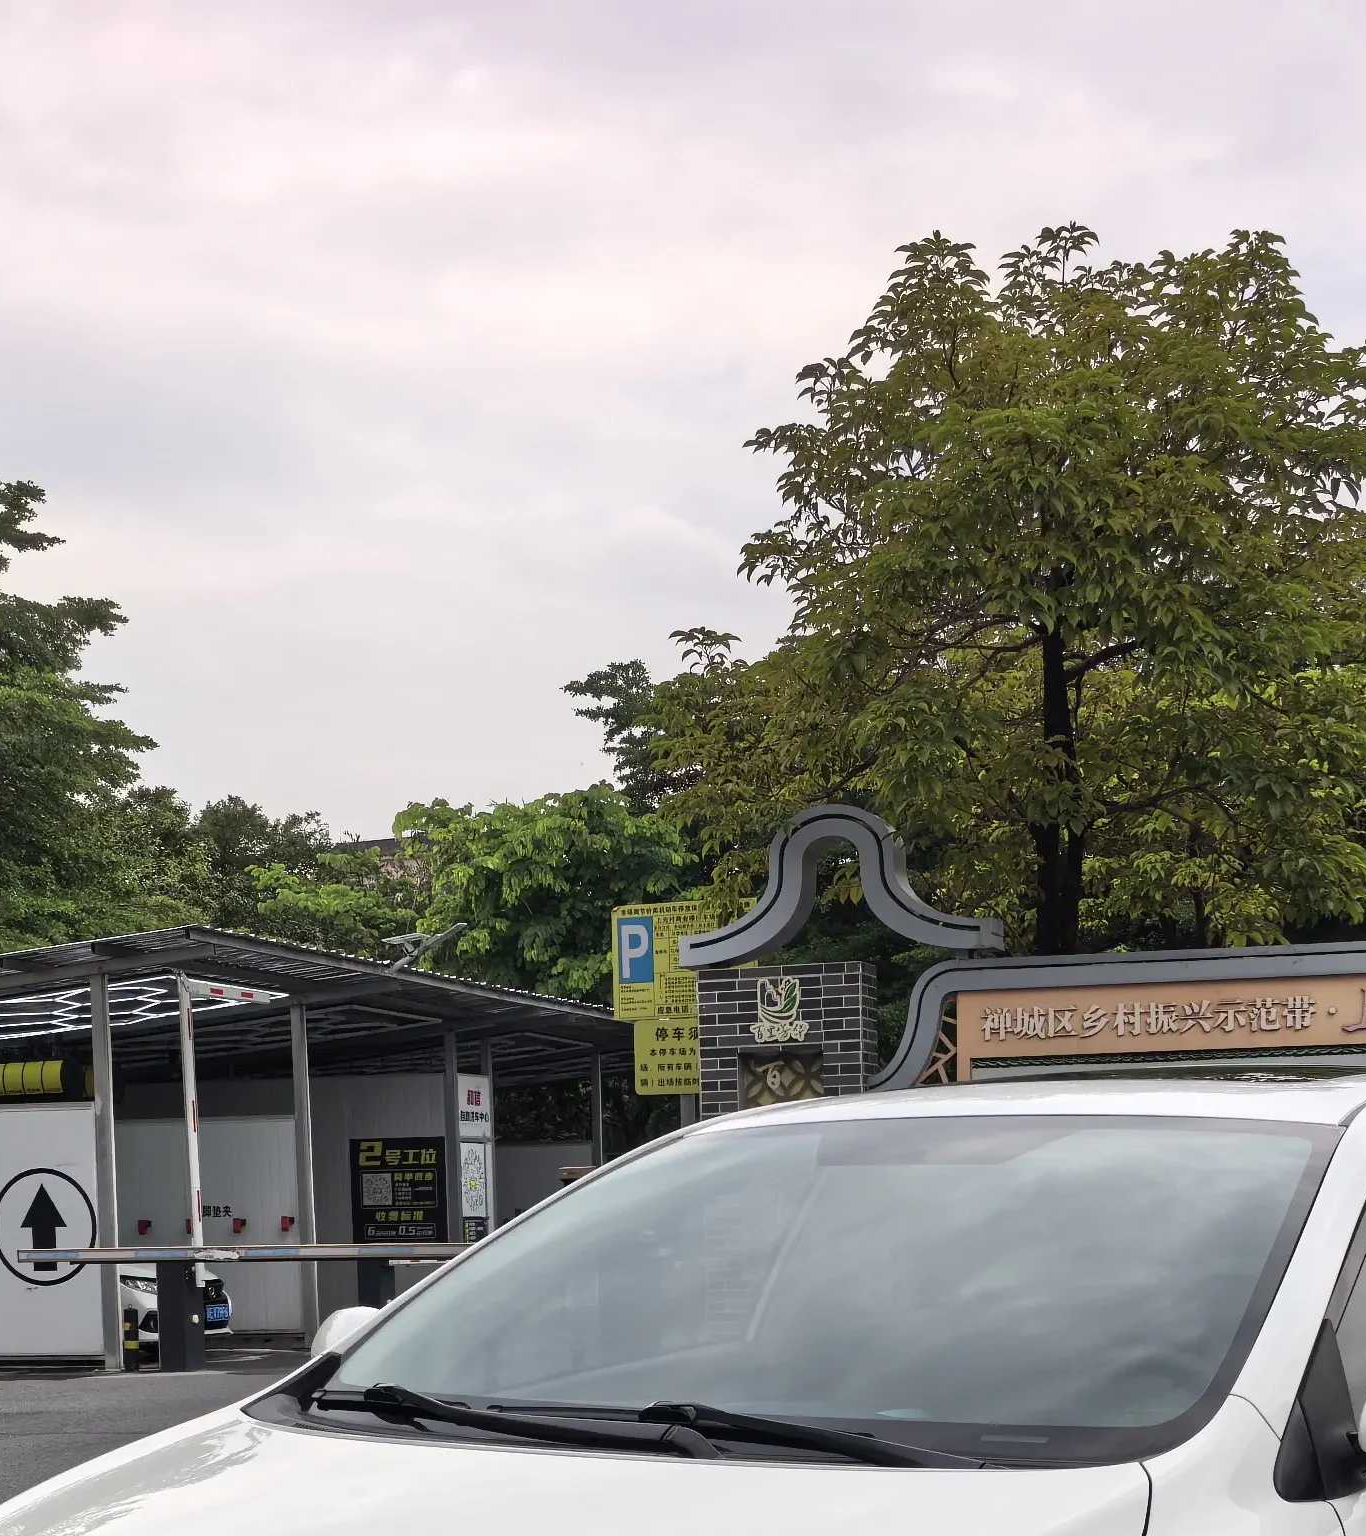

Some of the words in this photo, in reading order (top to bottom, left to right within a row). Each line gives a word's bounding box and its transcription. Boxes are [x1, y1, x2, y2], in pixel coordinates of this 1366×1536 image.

[621, 925, 649, 978] P
[359, 1141, 438, 1167] 2号工位
